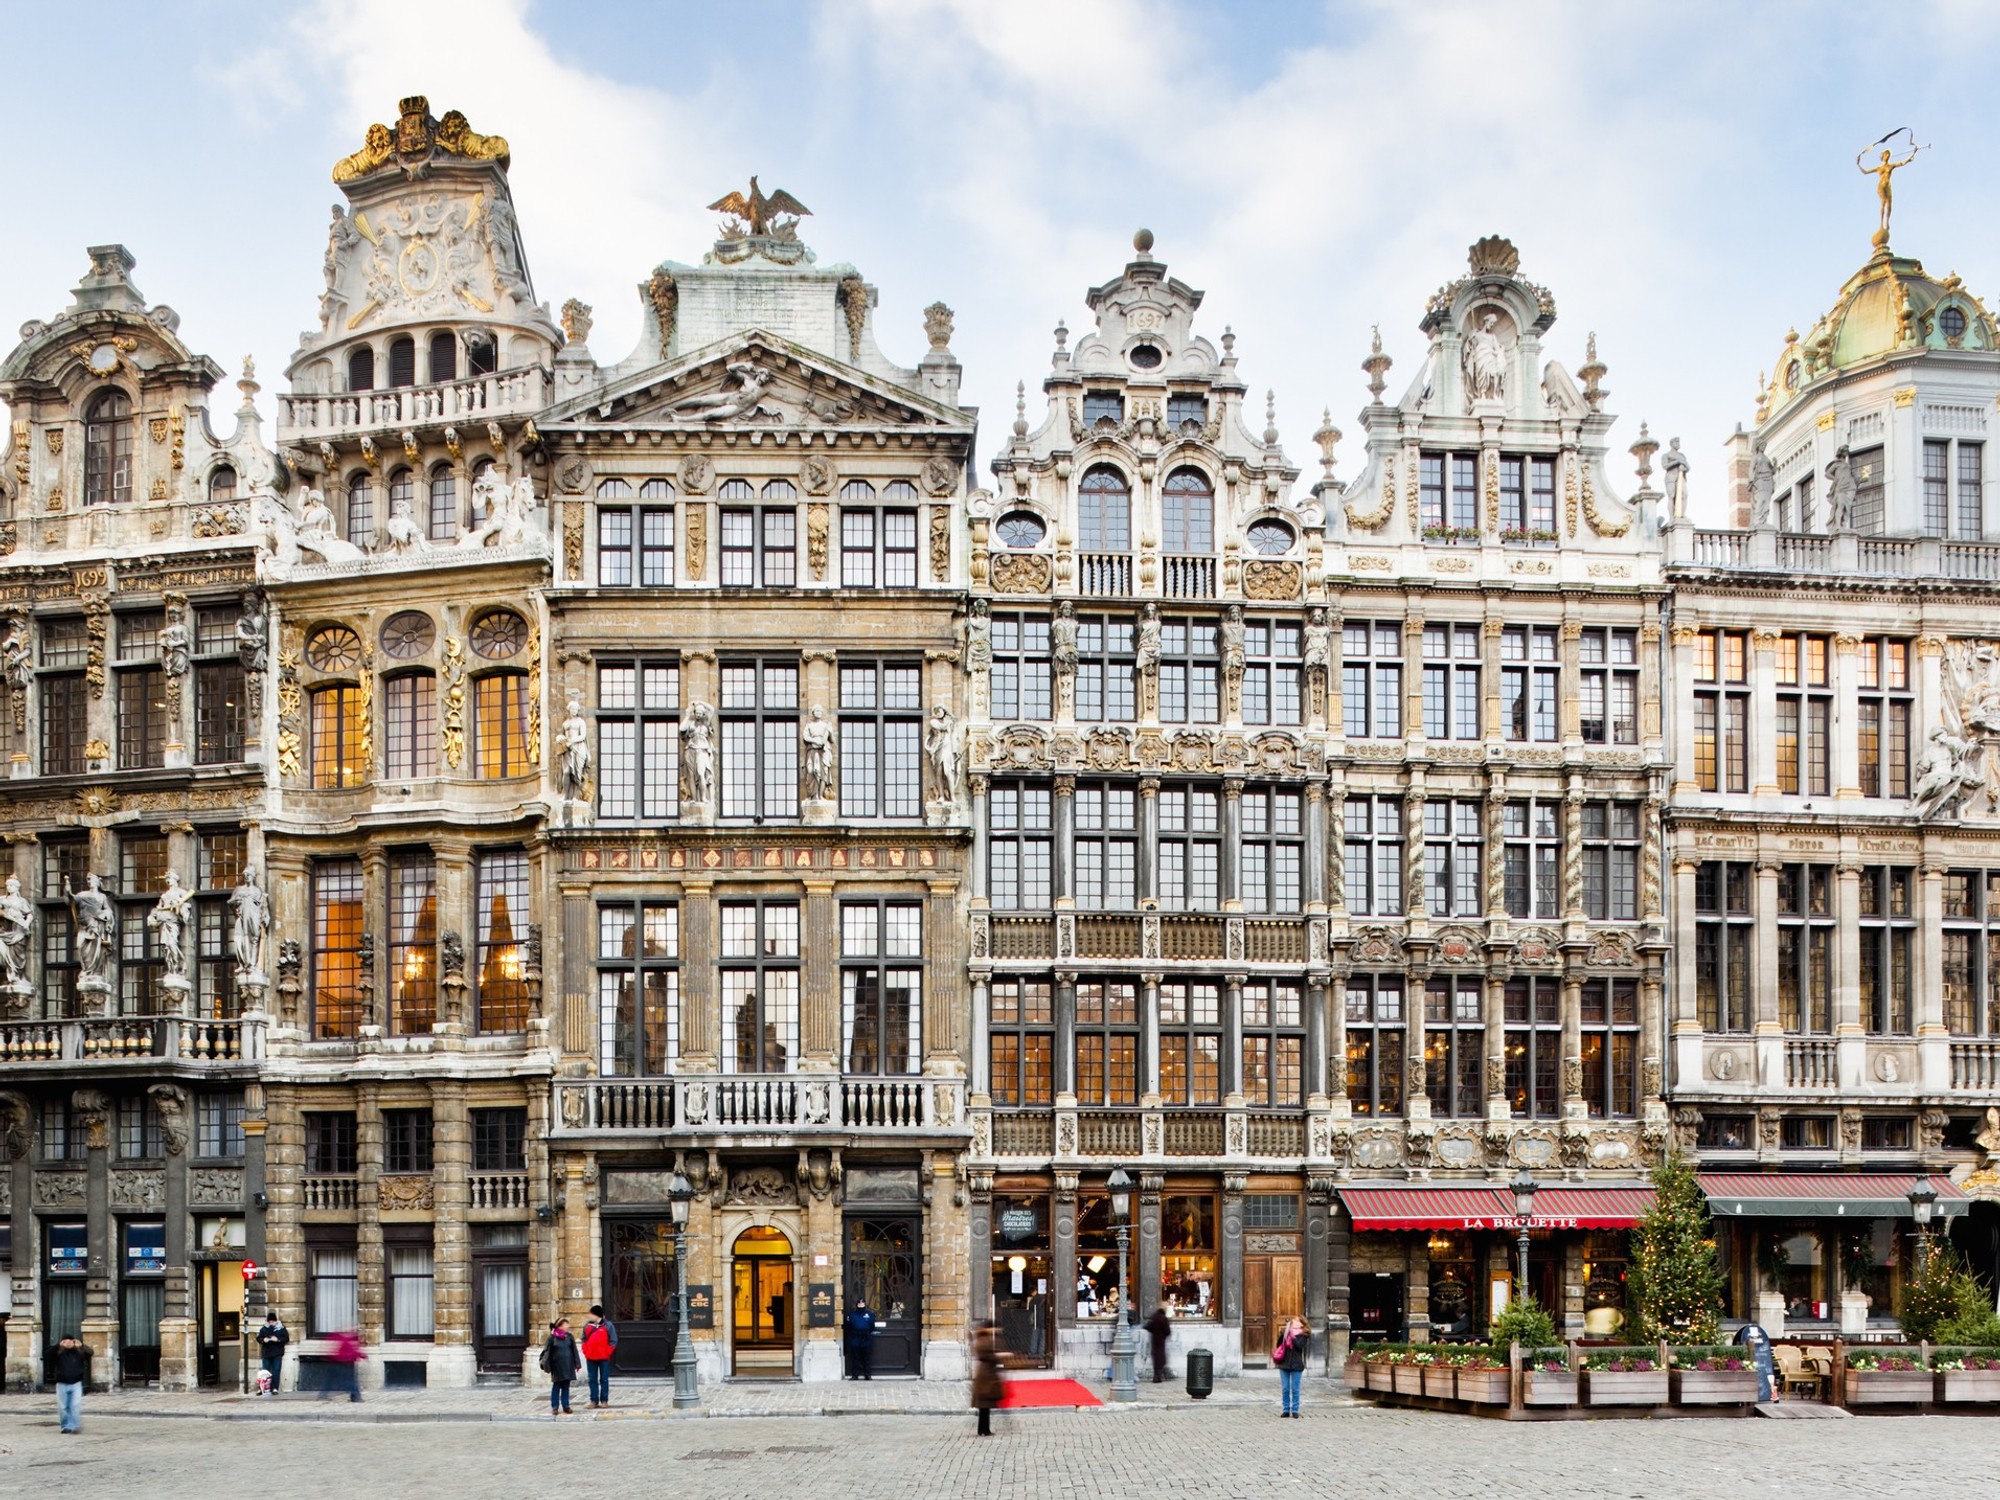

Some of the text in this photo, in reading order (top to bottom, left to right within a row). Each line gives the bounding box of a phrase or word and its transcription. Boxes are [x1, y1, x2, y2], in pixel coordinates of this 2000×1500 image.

[1129, 313, 1164, 328] 1697
[75, 570, 107, 588] 1699
[1788, 838, 1825, 850] PISTOR
[1464, 1218, 1577, 1228] LA BROUETTE
